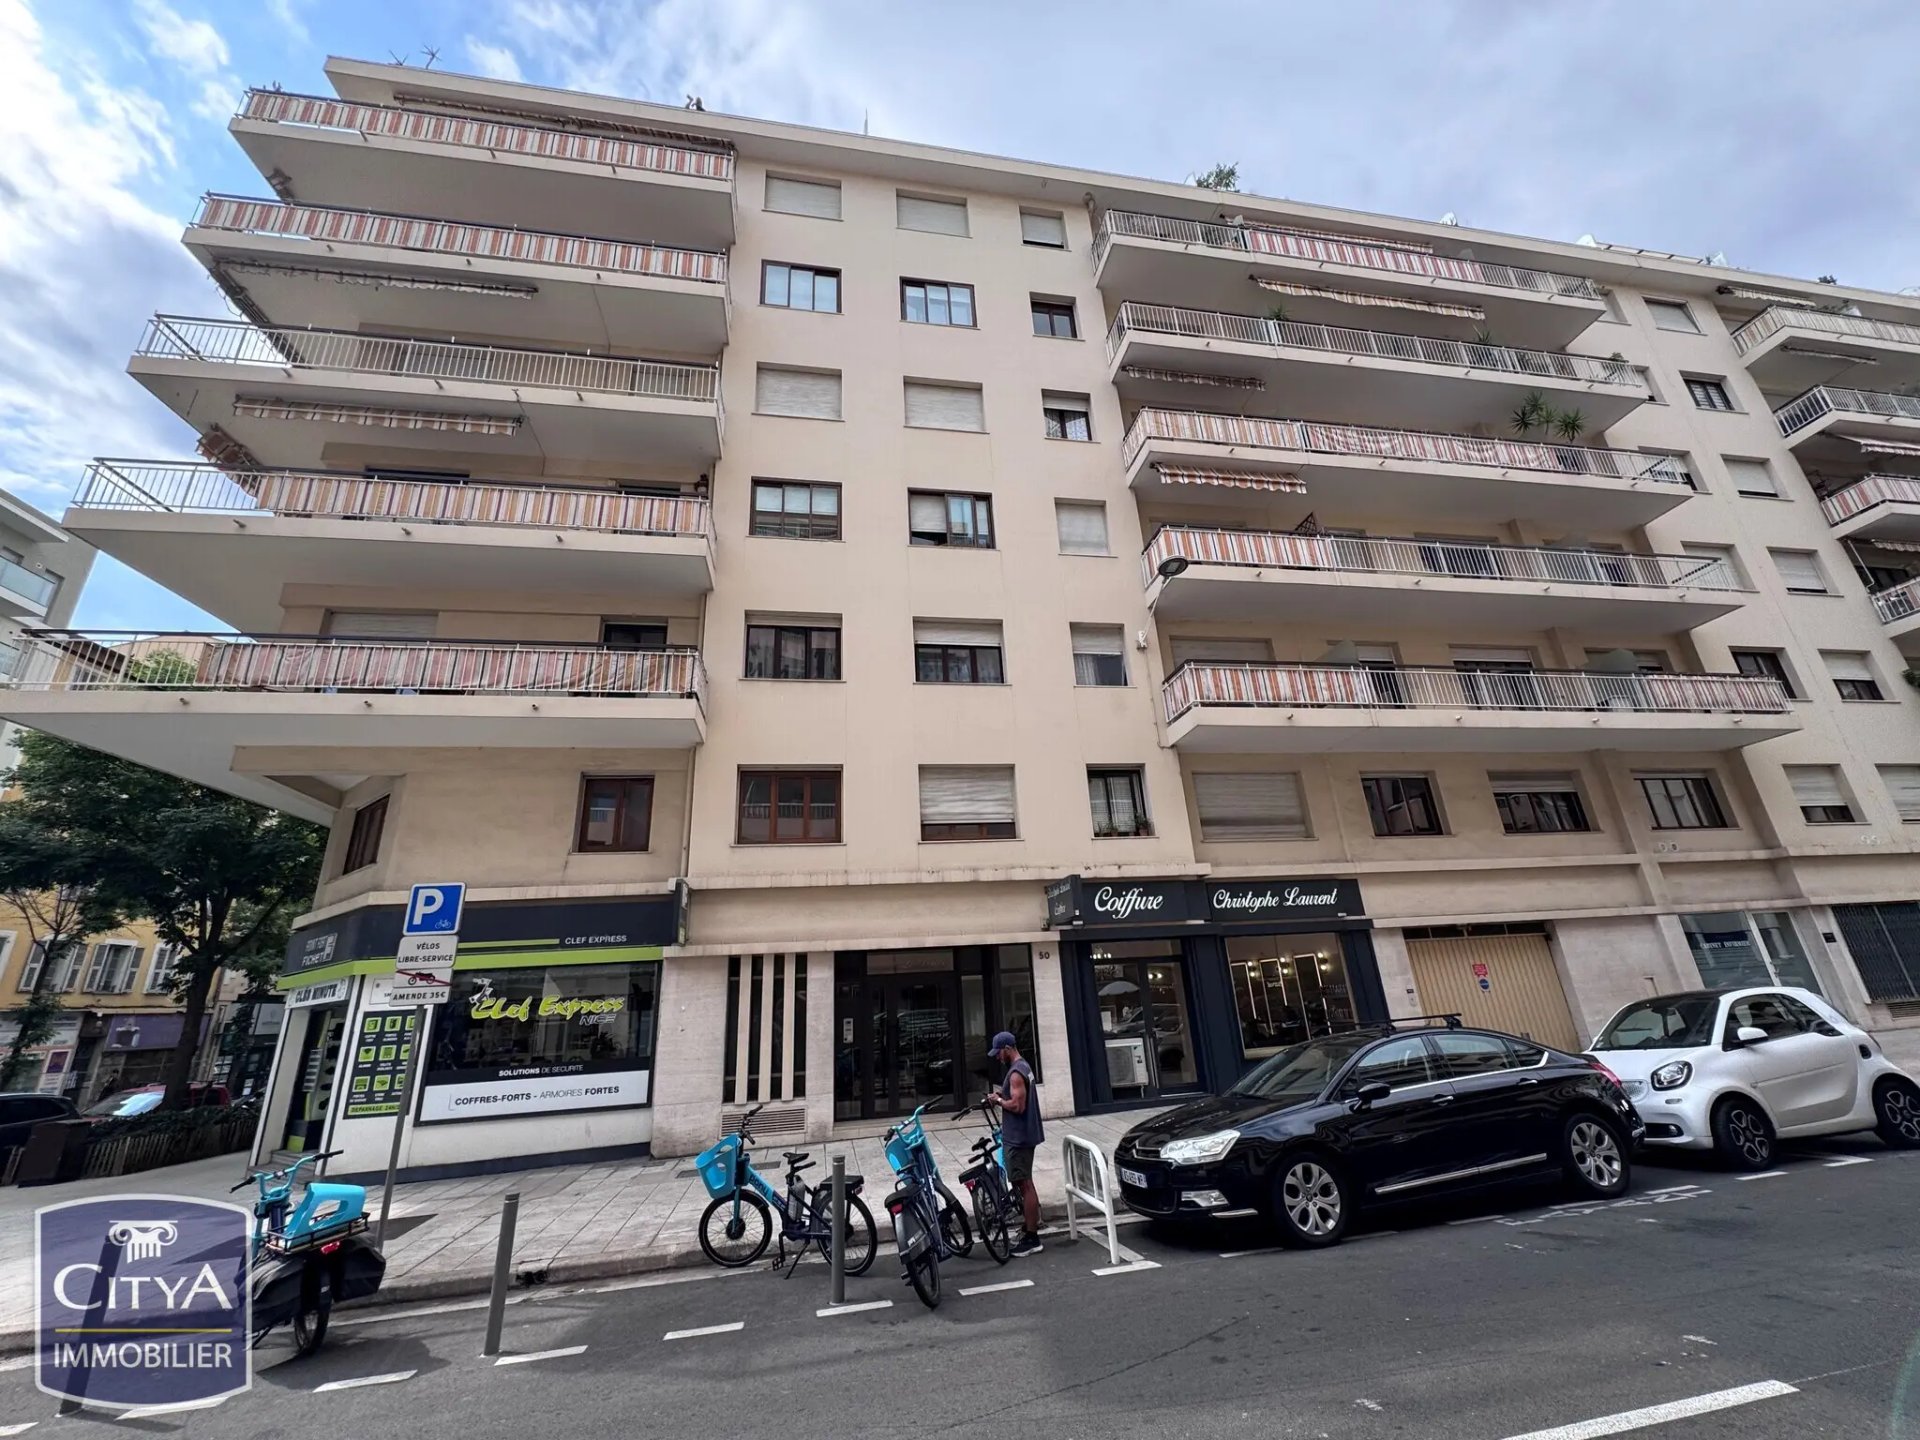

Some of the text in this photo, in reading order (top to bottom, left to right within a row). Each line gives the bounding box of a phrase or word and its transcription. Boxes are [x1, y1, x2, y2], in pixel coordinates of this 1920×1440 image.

[1094, 886, 1164, 919] Coiffure
[1213, 887, 1338, 913] Christophe Laurent
[412, 888, 444, 925] P
[416, 942, 440, 950] VÉLOS
[565, 935, 627, 945] CLEF EXPRESS
[398, 954, 453, 963] LIBRE-SERVICE
[1039, 951, 1050, 959] 50
[393, 992, 428, 1001] AMENDE
[429, 991, 446, 999] 35€
[471, 995, 625, 1022] Clef Express
[579, 1013, 617, 1026] NICE
[499, 1067, 540, 1077] SOLUTIONS
[541, 1066, 551, 1074] DE
[455, 1092, 532, 1106] COFFRES-FORTS
[539, 1088, 583, 1100] ARMOIRES
[584, 1085, 620, 1096] FORTES
